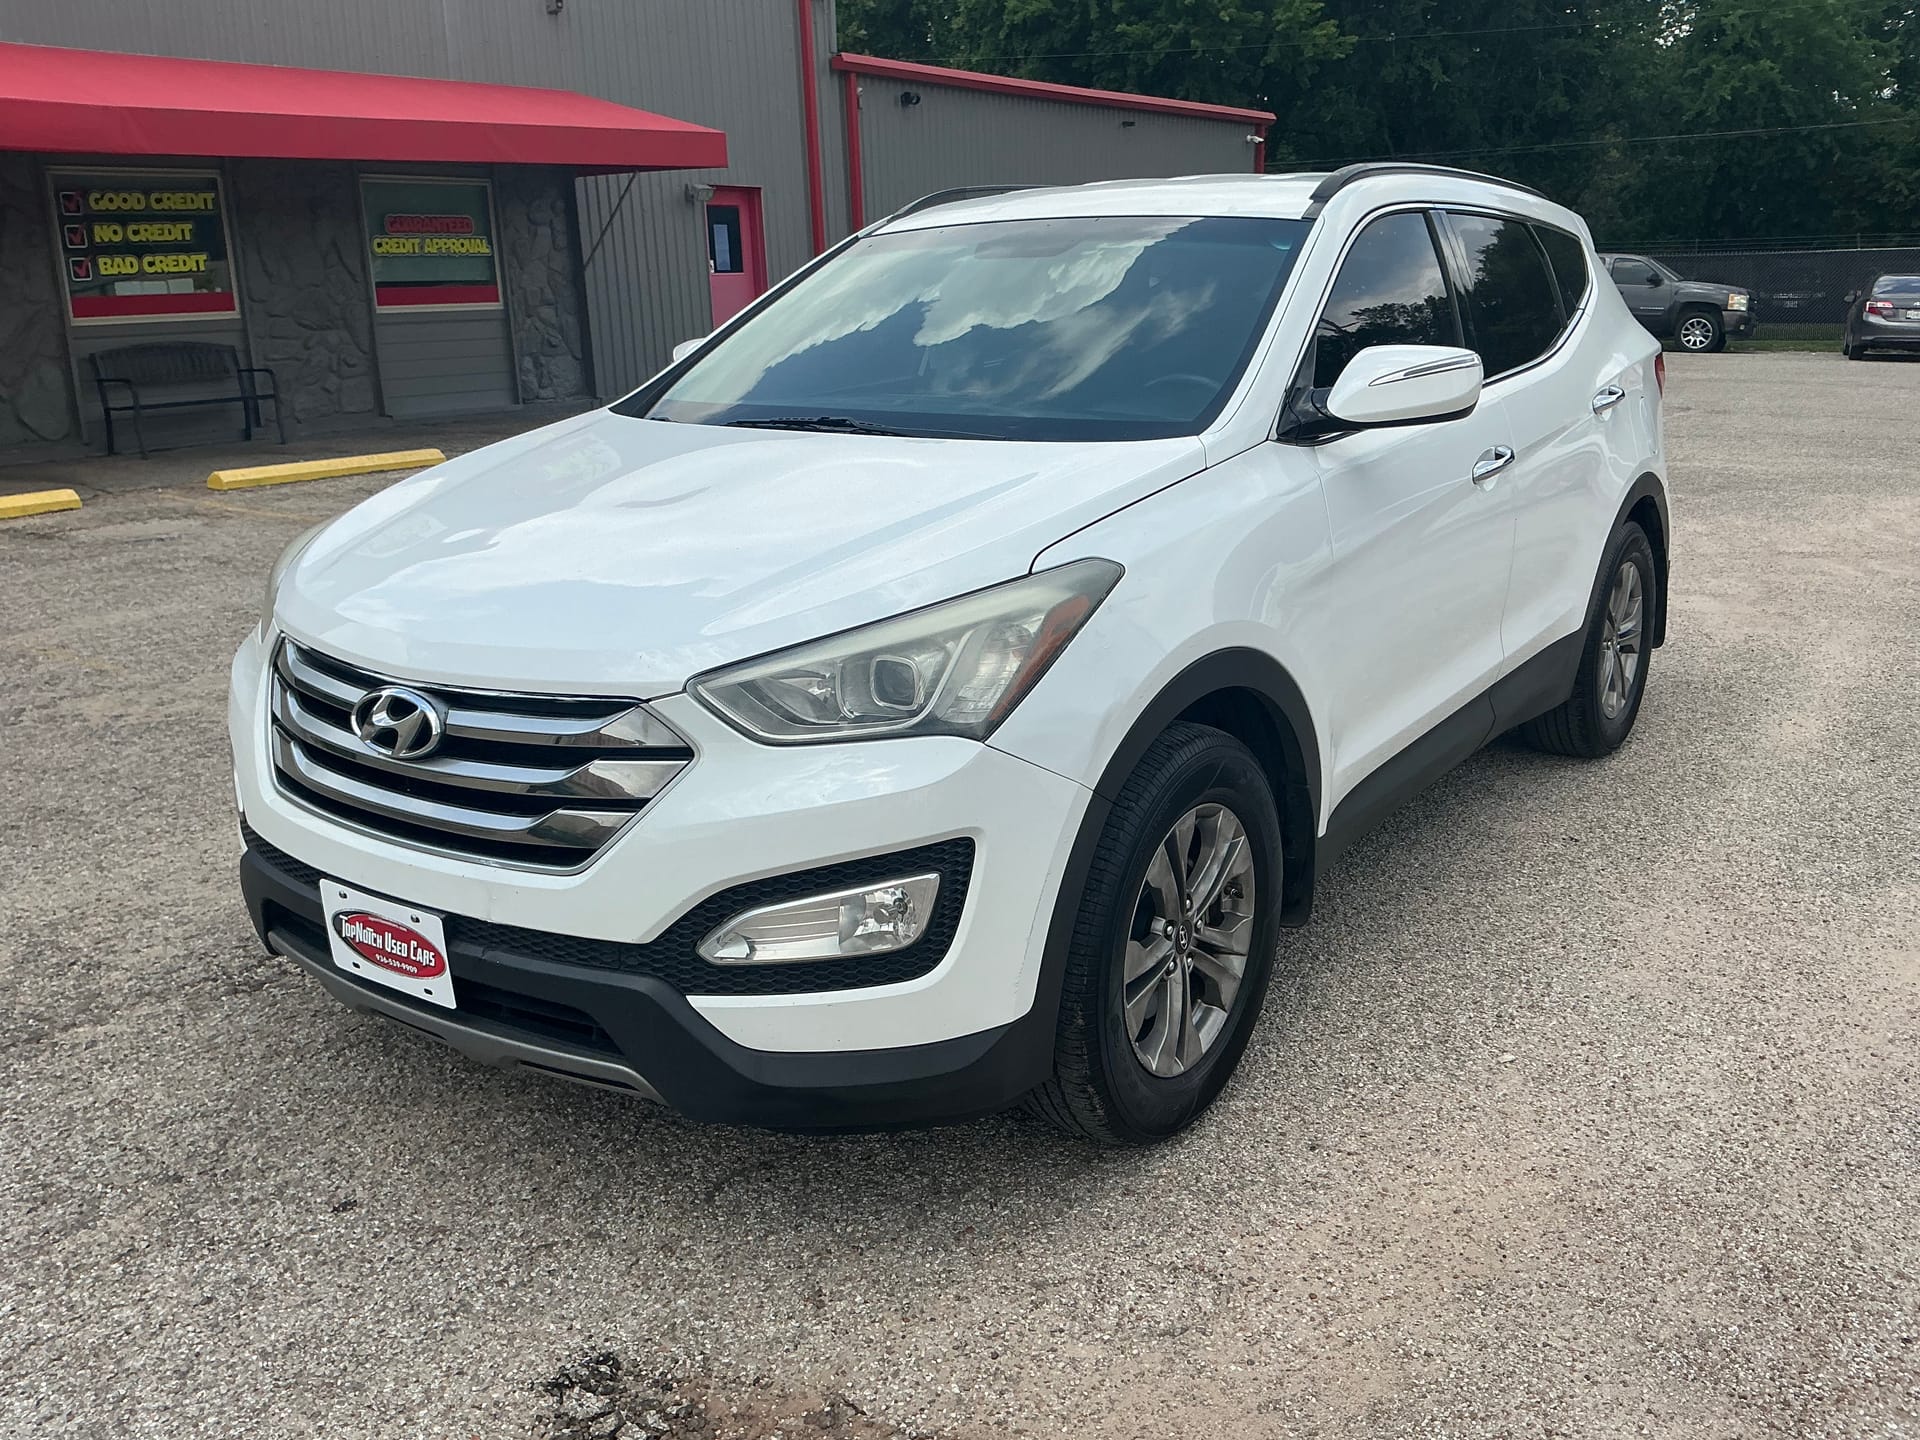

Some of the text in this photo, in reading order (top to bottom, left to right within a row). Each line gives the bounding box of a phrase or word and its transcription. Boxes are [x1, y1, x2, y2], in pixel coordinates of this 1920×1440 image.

[89, 192, 215, 210] GOOD CREDIT
[93, 223, 193, 243] NO CREDIT
[373, 237, 490, 254] CREDIT APPROVAL
[98, 254, 208, 275] BAD CREDIT
